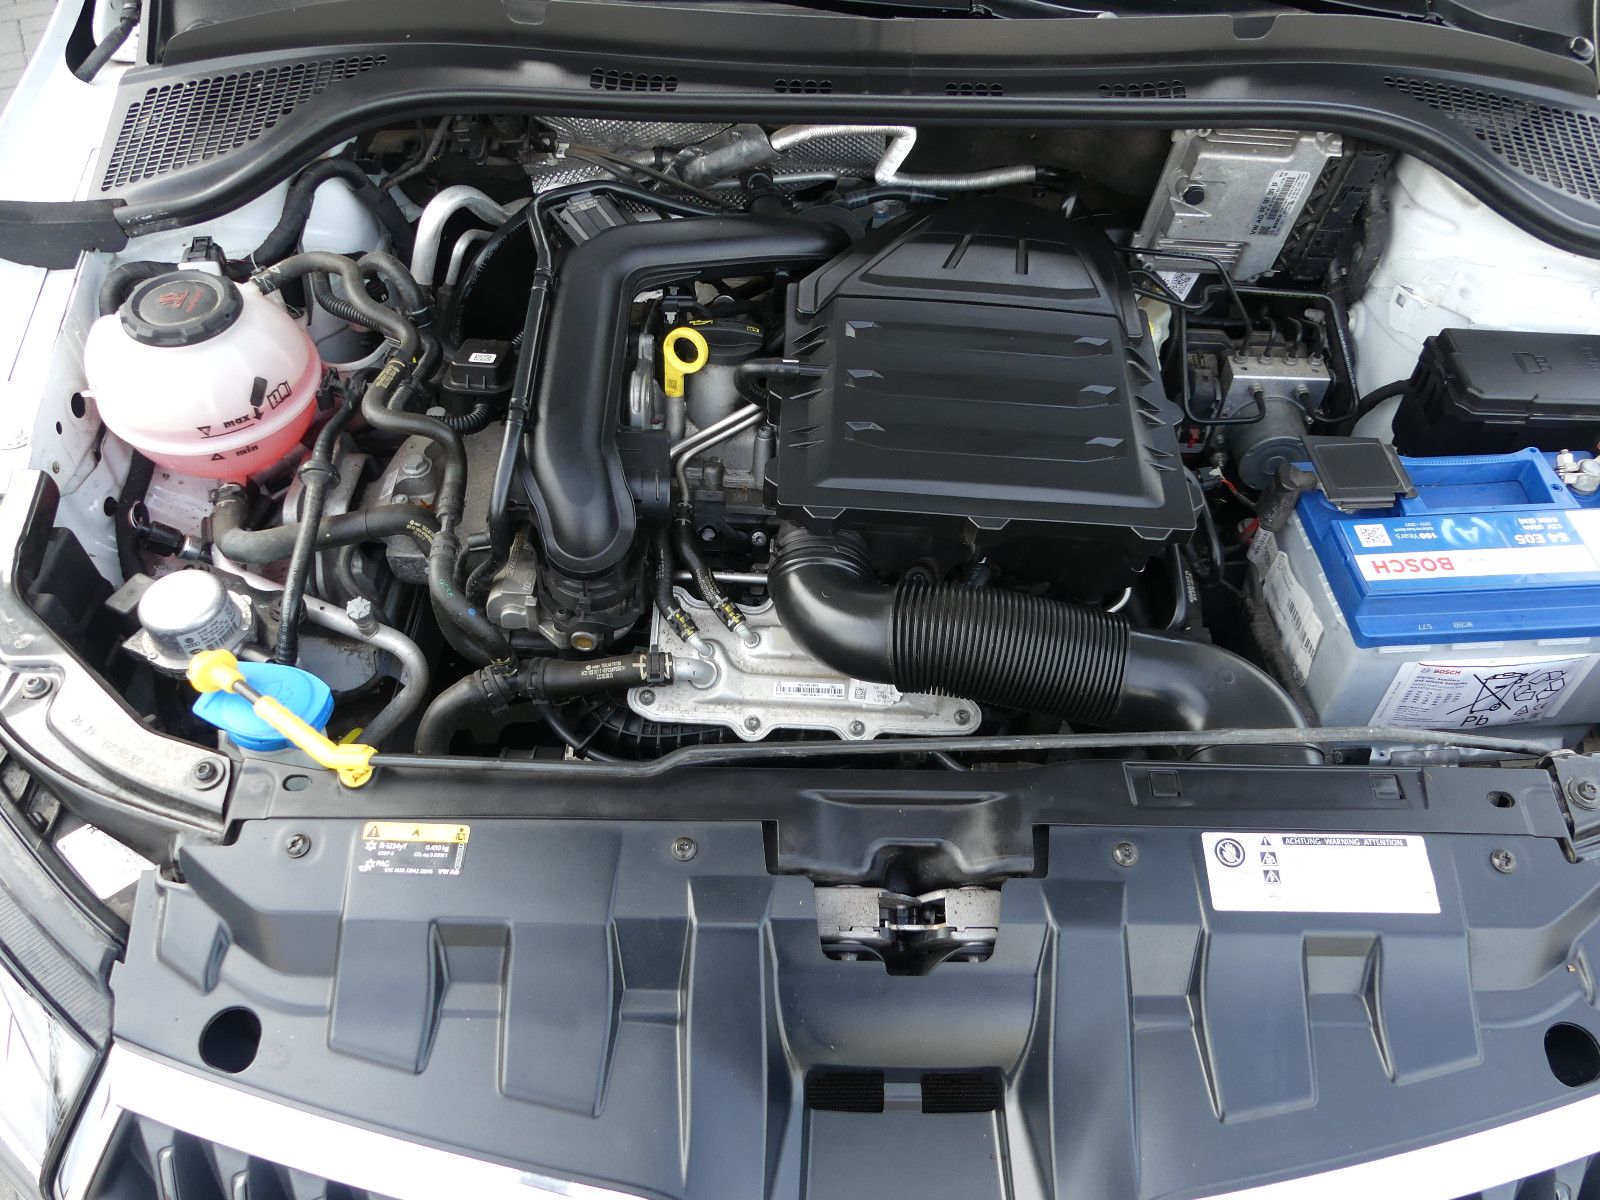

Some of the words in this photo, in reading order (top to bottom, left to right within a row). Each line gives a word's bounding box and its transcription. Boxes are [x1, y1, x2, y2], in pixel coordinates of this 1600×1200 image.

[223, 414, 250, 428] max
[235, 445, 259, 457] min
[1395, 533, 1420, 541] Years
[1419, 532, 1438, 540] 100
[1370, 557, 1455, 574] BOSCH
[1460, 714, 1490, 727] Pb
[1284, 837, 1321, 845] ACHTUNG
[1323, 838, 1361, 846] WARNING
[1363, 838, 1403, 847] ATTENTION
